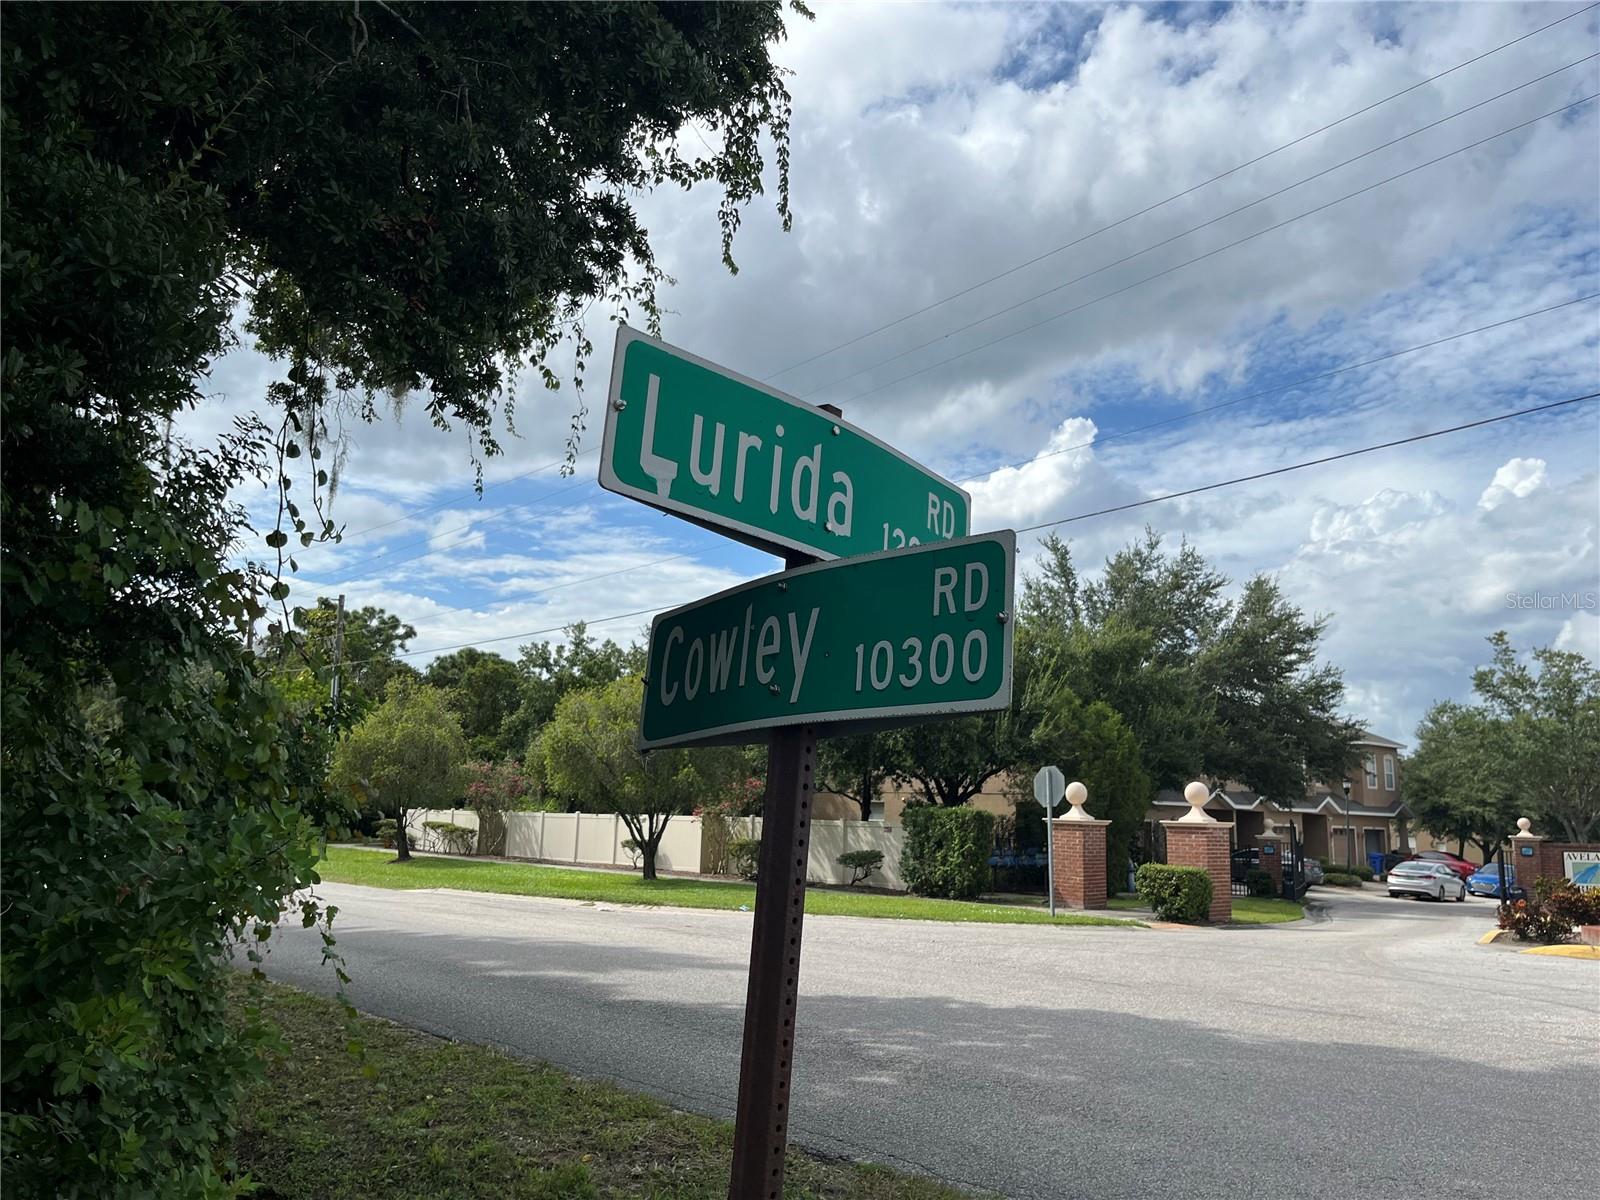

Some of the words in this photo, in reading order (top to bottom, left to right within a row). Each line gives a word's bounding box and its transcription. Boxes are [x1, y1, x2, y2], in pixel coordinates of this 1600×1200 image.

[639, 373, 854, 538] Lurida
[926, 491, 956, 540] RD
[933, 561, 989, 617] RD
[660, 603, 820, 705] Cowley
[854, 629, 988, 693] 10300
